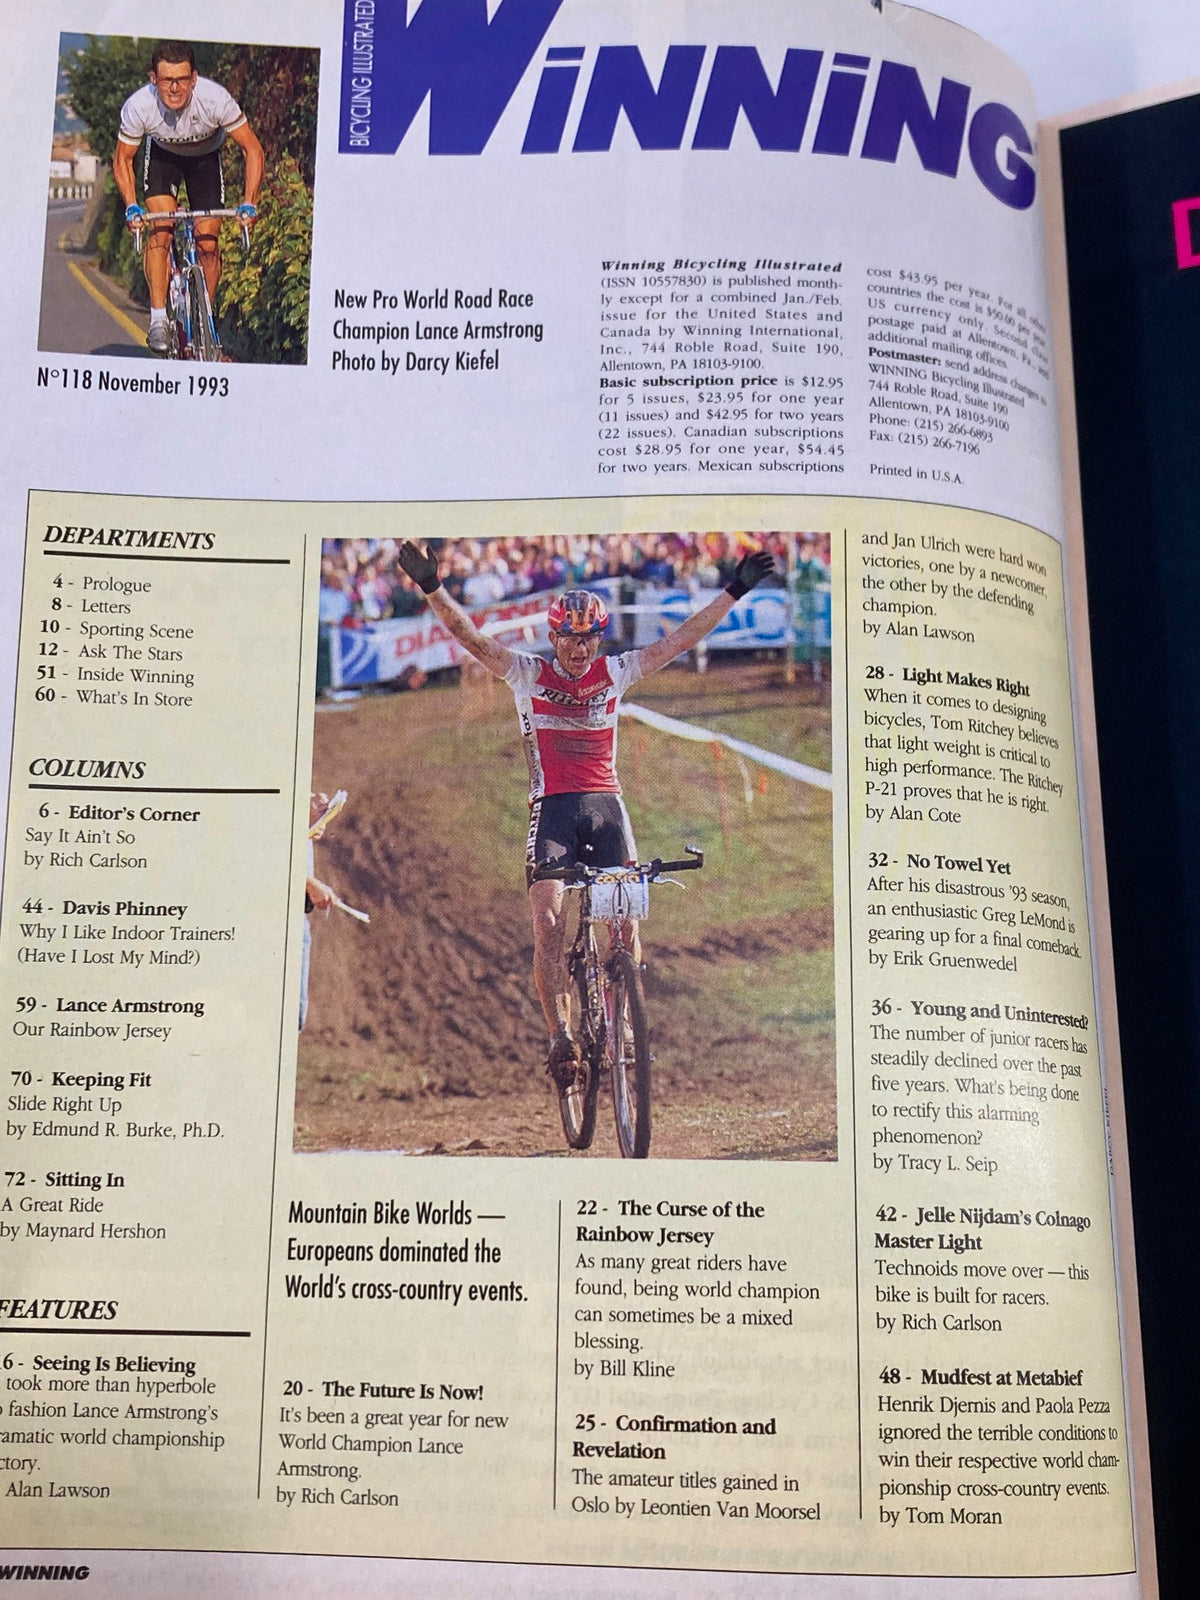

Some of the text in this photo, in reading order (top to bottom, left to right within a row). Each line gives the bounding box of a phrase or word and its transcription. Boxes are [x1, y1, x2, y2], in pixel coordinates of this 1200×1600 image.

[349, 0, 375, 146] BICYCLING ILLUSTRATED
[602, 259, 842, 273] Winning Bicycling Illustrated
[601, 275, 842, 289] (ISSN 10557830) is published month-
[334, 288, 534, 310] New Pro World Road Race
[333, 320, 544, 345] Champion Lance Armstrong
[332, 350, 499, 375] Photo by Darcy Kiefel
[600, 358, 764, 373] Allentown, PA 18103-9100.
[868, 347, 941, 366] Postmaster:
[98, 371, 181, 395] November
[188, 375, 229, 398] 1993
[600, 375, 843, 390] Basic subscription price is $12.95
[869, 396, 1010, 432] Allentown, PA 18103-9100
[869, 413, 994, 444] Phone: (215) 266-6893
[869, 430, 980, 455] Fax: (215) 266-7196
[598, 460, 844, 477] for two years. Mexican subscriptions
[870, 464, 965, 485] Printed in U.S.A.
[42, 526, 216, 550] DEPARTMENTS
[53, 573, 152, 595] 4 Prologue
[51, 597, 131, 614] 8 Letters
[40, 620, 194, 641] 10 Sporting Scene
[39, 643, 183, 661] 12 Ask The Stars
[37, 665, 195, 688] 51 Inside Winning
[865, 666, 1031, 698] 28 Light Makes Right
[35, 687, 193, 707] 60 What's In Store
[29, 758, 146, 780] COLUMNS
[39, 803, 201, 822] 6 Editor's Corner
[868, 852, 1012, 875] 32 No Towel Yet
[22, 898, 188, 920] 44 Davis Phinney
[16, 997, 205, 1018] 59 Lance Armstrong
[11, 1071, 152, 1091] 70 Keeping Fit
[872, 1126, 983, 1147] phenomenon?
[5, 1172, 125, 1192] 72 Sitting In
[289, 1200, 472, 1226] Mountain Bike Worlds
[577, 1201, 765, 1218] 22 The Curse of the
[875, 1204, 1091, 1233] 42 Jelle Nijdam's Colnago
[0, 1221, 166, 1243] by Maynard Hershon
[576, 1226, 714, 1248] Rainbow Jersey
[287, 1238, 502, 1266] Europeans dominated the
[875, 1233, 983, 1254] Master Light
[285, 1274, 529, 1306] World's cross-country events.
[33, 1355, 196, 1377] Seeing Is Believing
[878, 1366, 1084, 1387] 48 Mudfest at Metabief
[282, 1380, 484, 1401] 20 The Future Is Now!
[575, 1414, 777, 1436] 25 Confirmation and
[573, 1441, 667, 1460] Revelation
[5, 1480, 110, 1499] Alan Lawson
[572, 1496, 821, 1521] Oslo by Leontien Van Moorsel
[879, 1506, 1003, 1528] by Tom Moran
[0, 1565, 91, 1581] WINNING
